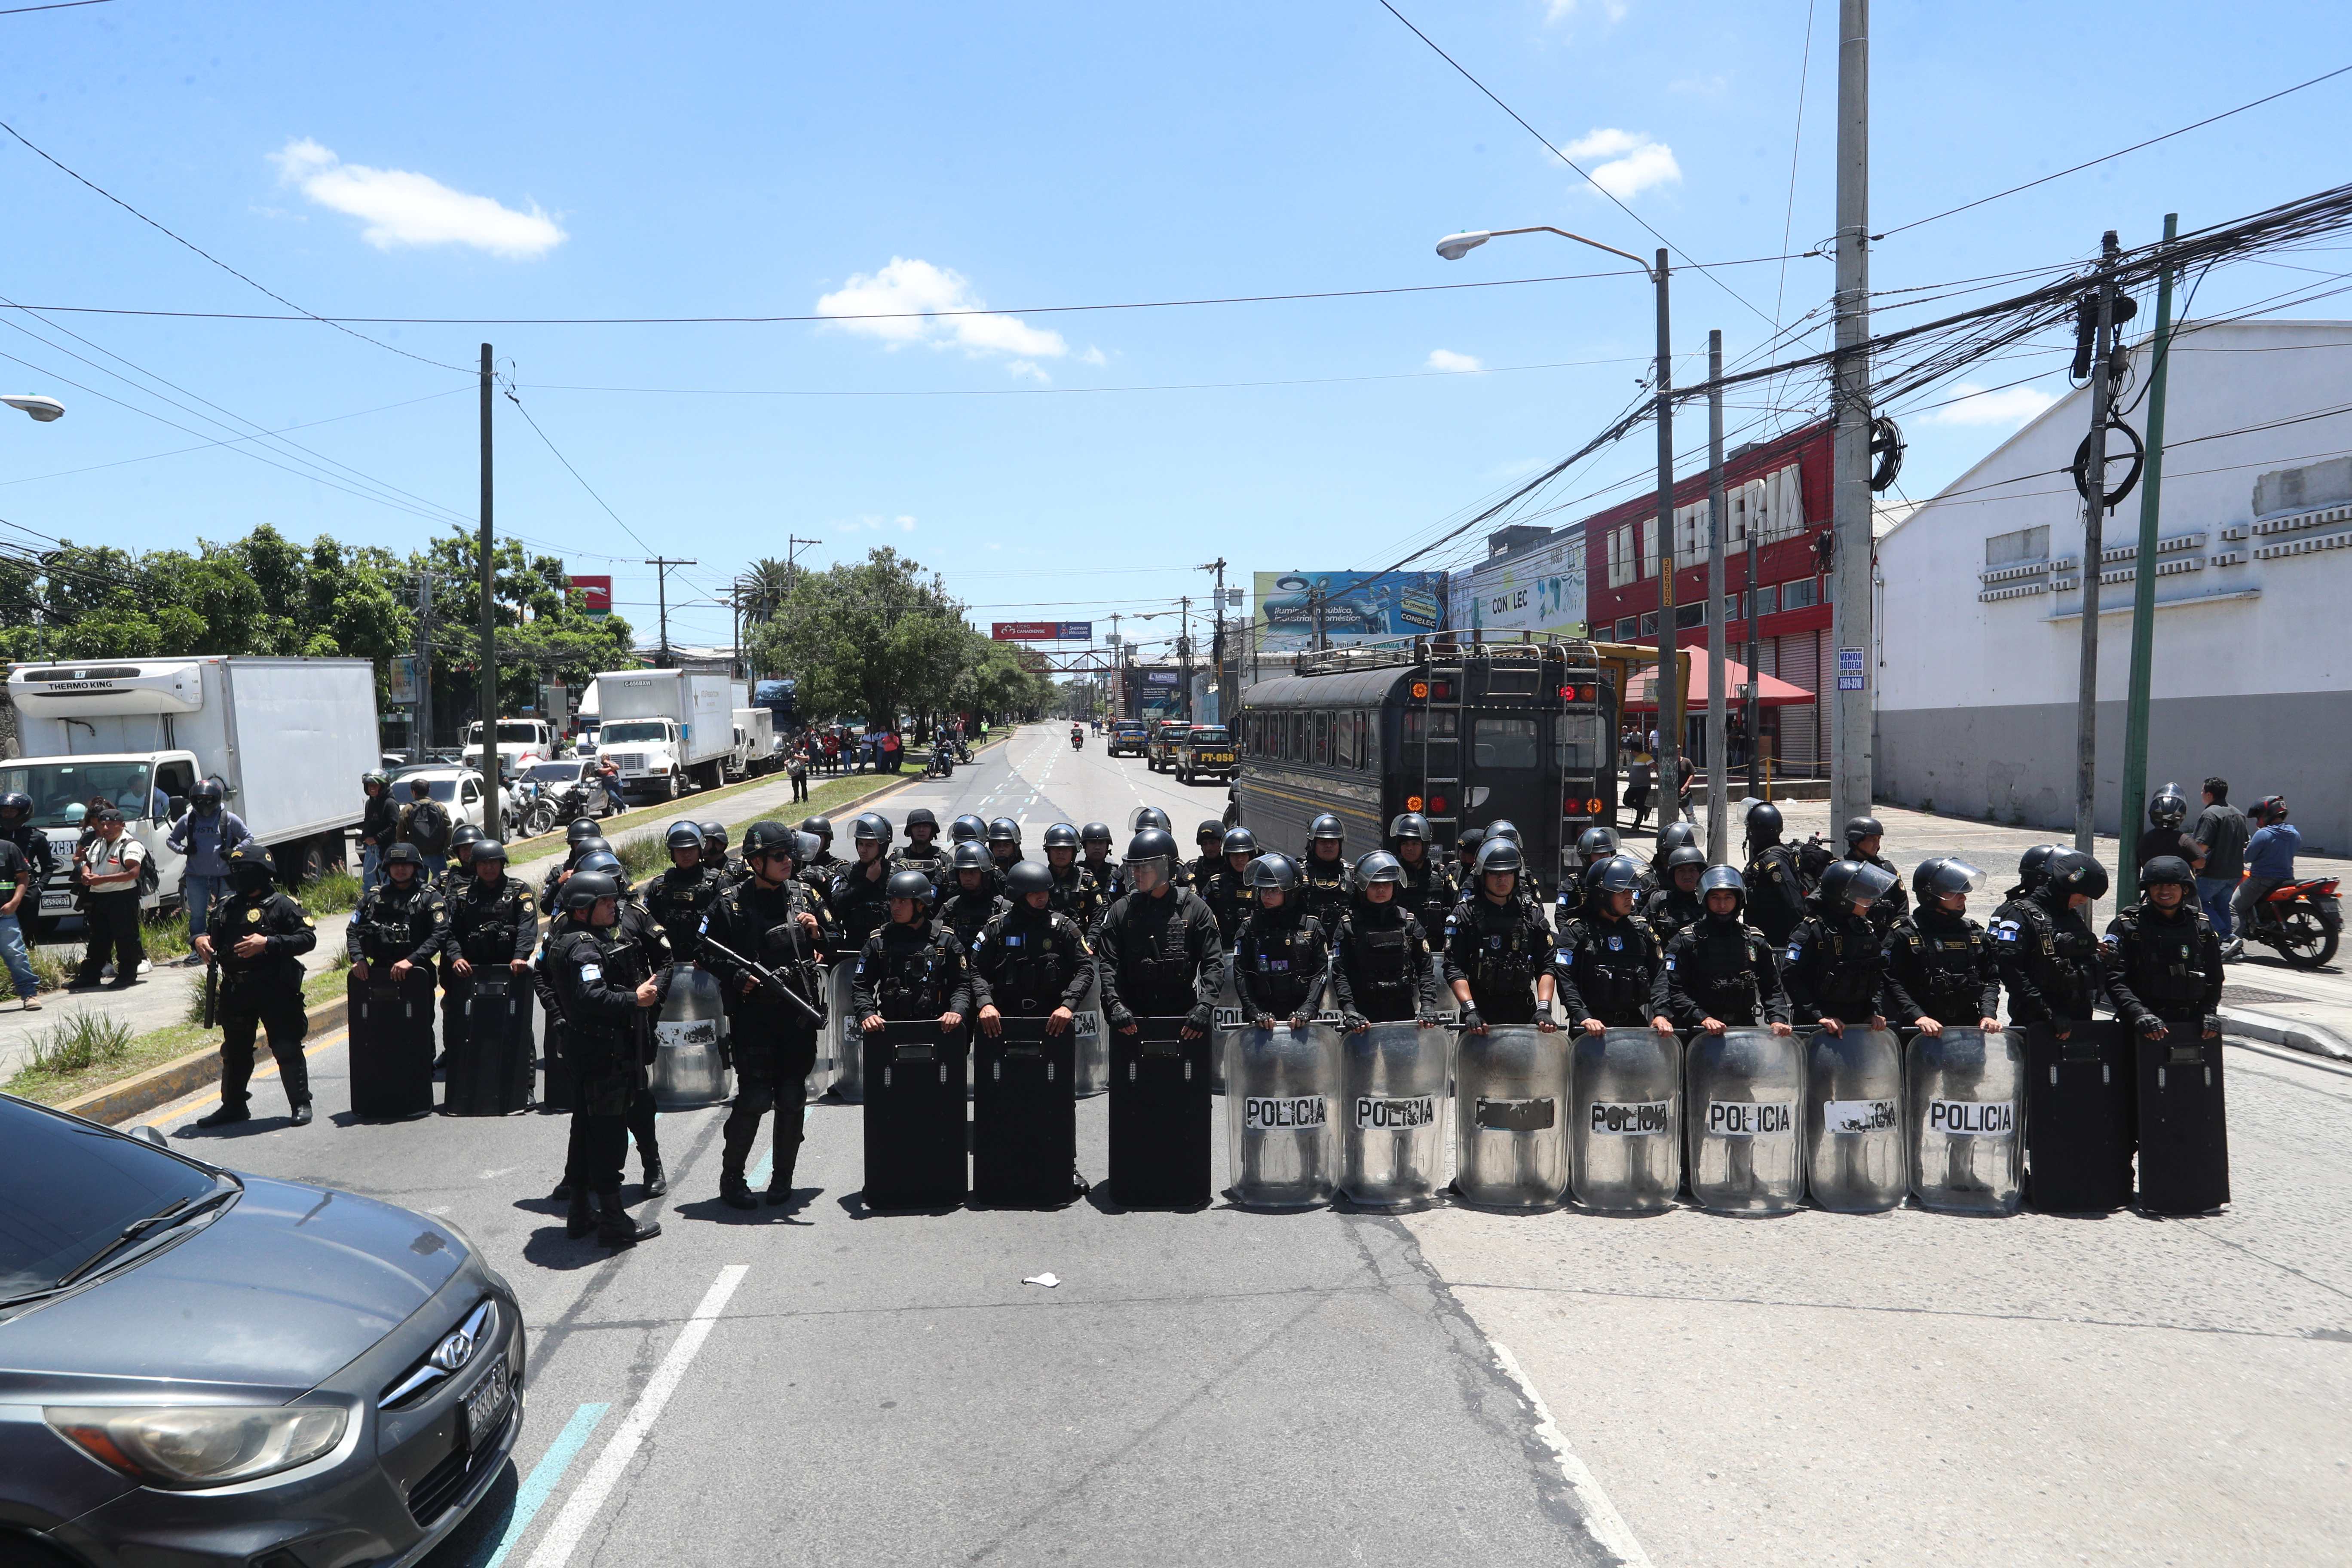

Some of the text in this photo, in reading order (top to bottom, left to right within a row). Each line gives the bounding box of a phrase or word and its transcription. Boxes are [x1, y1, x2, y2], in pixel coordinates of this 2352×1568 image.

[1607, 463, 1804, 589] LA MEBERIA
[1840, 678, 1862, 689] 3569-3248
[1201, 753, 1234, 762] FT-058
[1247, 1097, 1326, 1126] POLICIA
[1710, 1104, 1790, 1133] POLICIA
[1930, 1104, 2012, 1132] POLICIA
